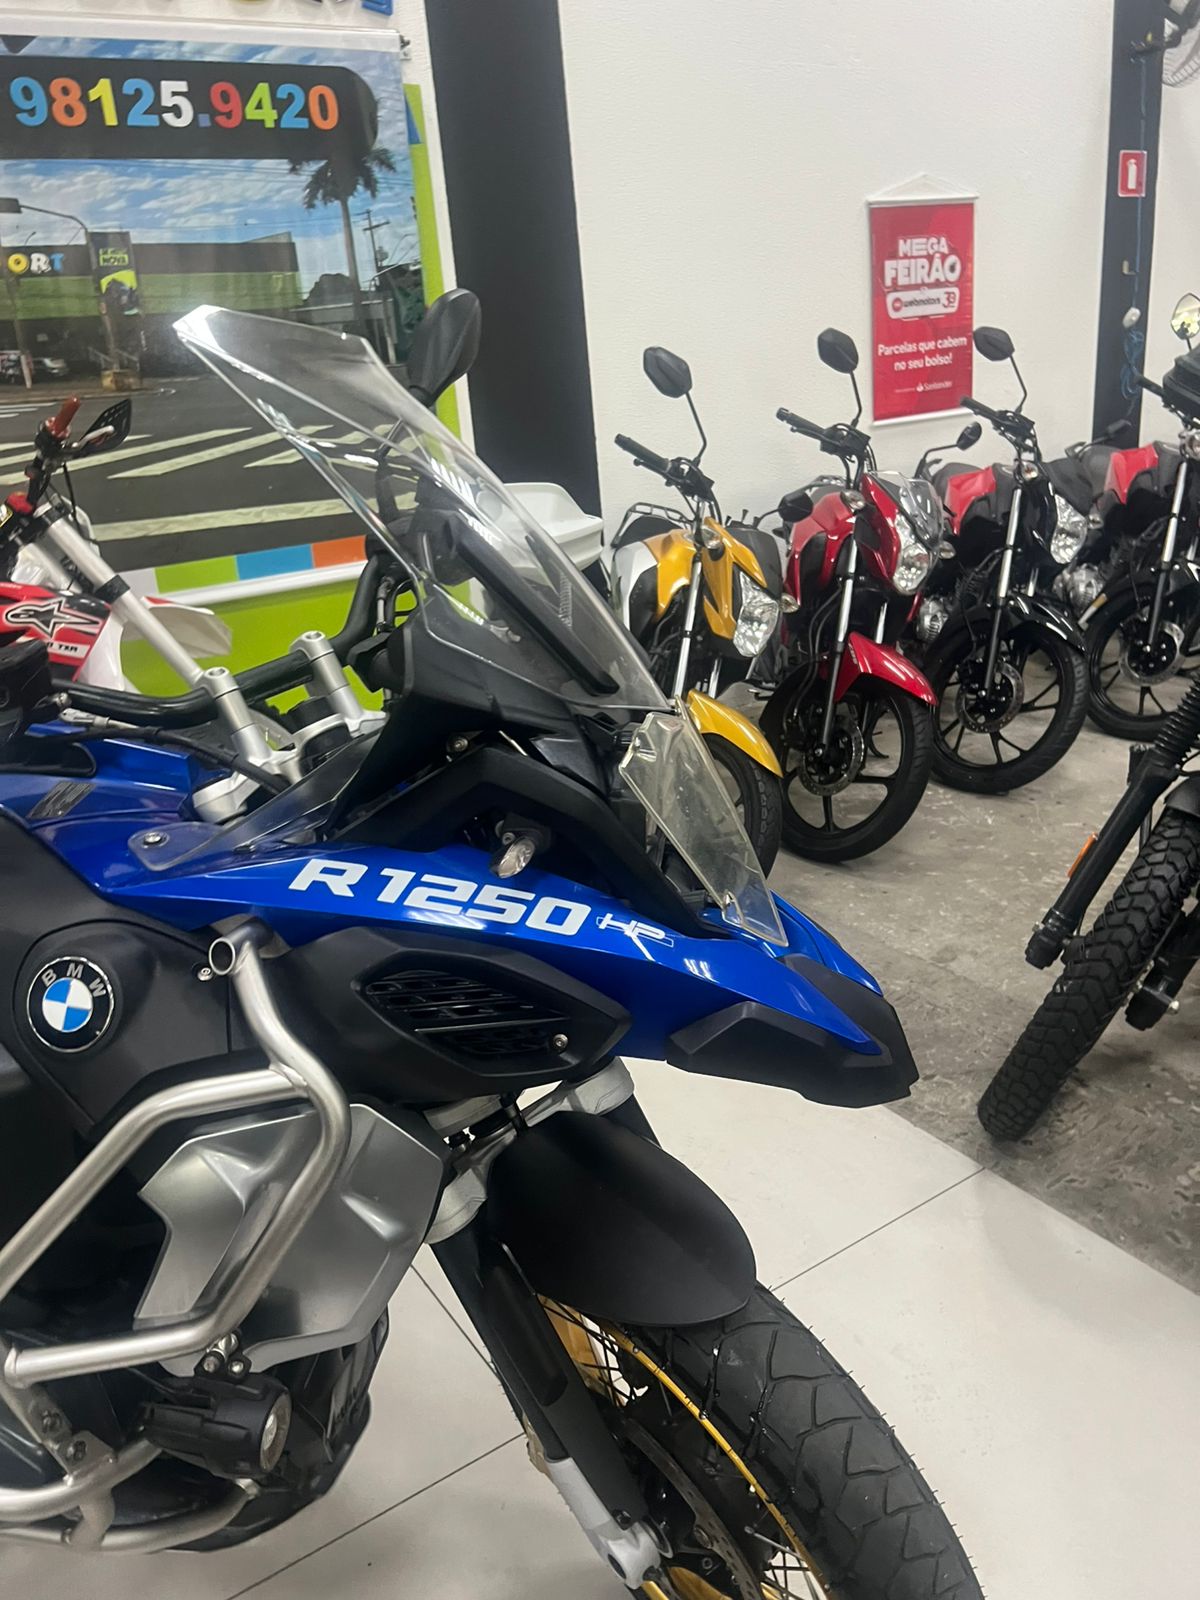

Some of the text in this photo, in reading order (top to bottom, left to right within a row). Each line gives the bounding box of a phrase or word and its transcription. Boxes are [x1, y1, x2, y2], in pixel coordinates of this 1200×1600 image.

[9, 76, 340, 131] 98125.9420
[898, 237, 949, 257] MEGA
[884, 253, 961, 287] FEIRÃO
[878, 335, 968, 356] Parcelas que cabem
[894, 352, 953, 371] no seu bolso!
[288, 858, 369, 898] R
[376, 867, 592, 936] 1250
[41, 963, 106, 998] BMW
